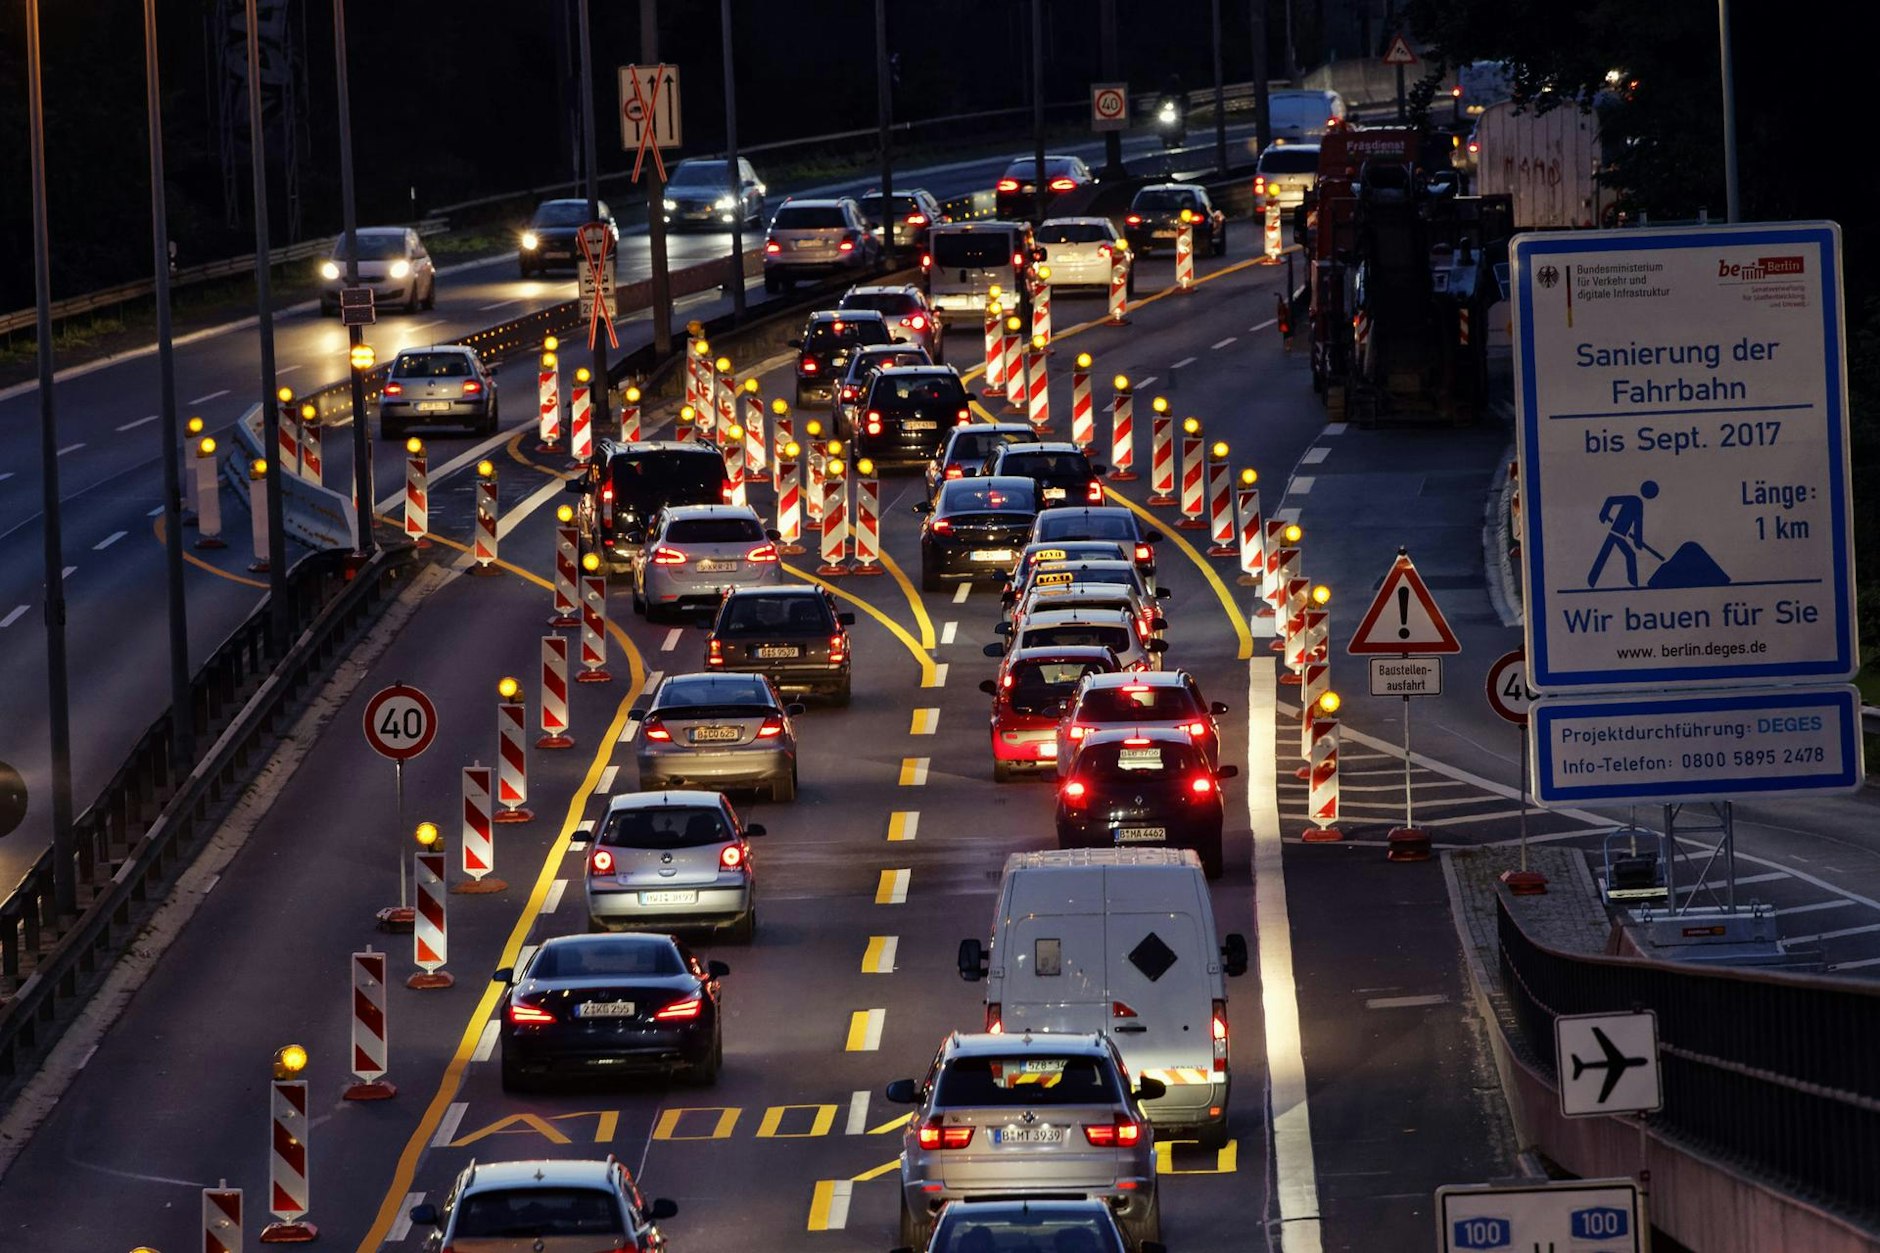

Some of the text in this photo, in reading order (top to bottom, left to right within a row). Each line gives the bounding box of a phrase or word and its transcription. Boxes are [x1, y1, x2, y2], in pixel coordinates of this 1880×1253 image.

[1101, 97, 1118, 111] 40
[1577, 262, 1664, 275] Bundesministerium
[1767, 260, 1801, 274] Berlin
[1577, 274, 1647, 287] für Verkehr und
[1577, 286, 1671, 301] digitale Infrastruktur
[1576, 338, 1780, 369] Sanierung der
[1612, 377, 1746, 404] Fahrbahn
[1585, 422, 1782, 455] bis Sept. 2017
[1741, 480, 1816, 509] Länge:
[1755, 516, 1809, 540] 1 km
[1563, 600, 1818, 634] Wir bauen für Sie
[1617, 641, 1767, 659] www. berlin.deges.de
[1379, 664, 1432, 676] Baustellen-
[1386, 679, 1426, 691] ausfahrt
[380, 707, 421, 739] 40
[1562, 716, 1822, 744] Projektdurchführung: DEGES
[1563, 747, 1824, 774] Info-Telefon: 0800 5895 2478
[1016, 1131, 1029, 1141] MT
[1034, 1130, 1060, 1140] 3939
[1464, 1220, 1501, 1244] 100
[1581, 1211, 1618, 1235] 100
